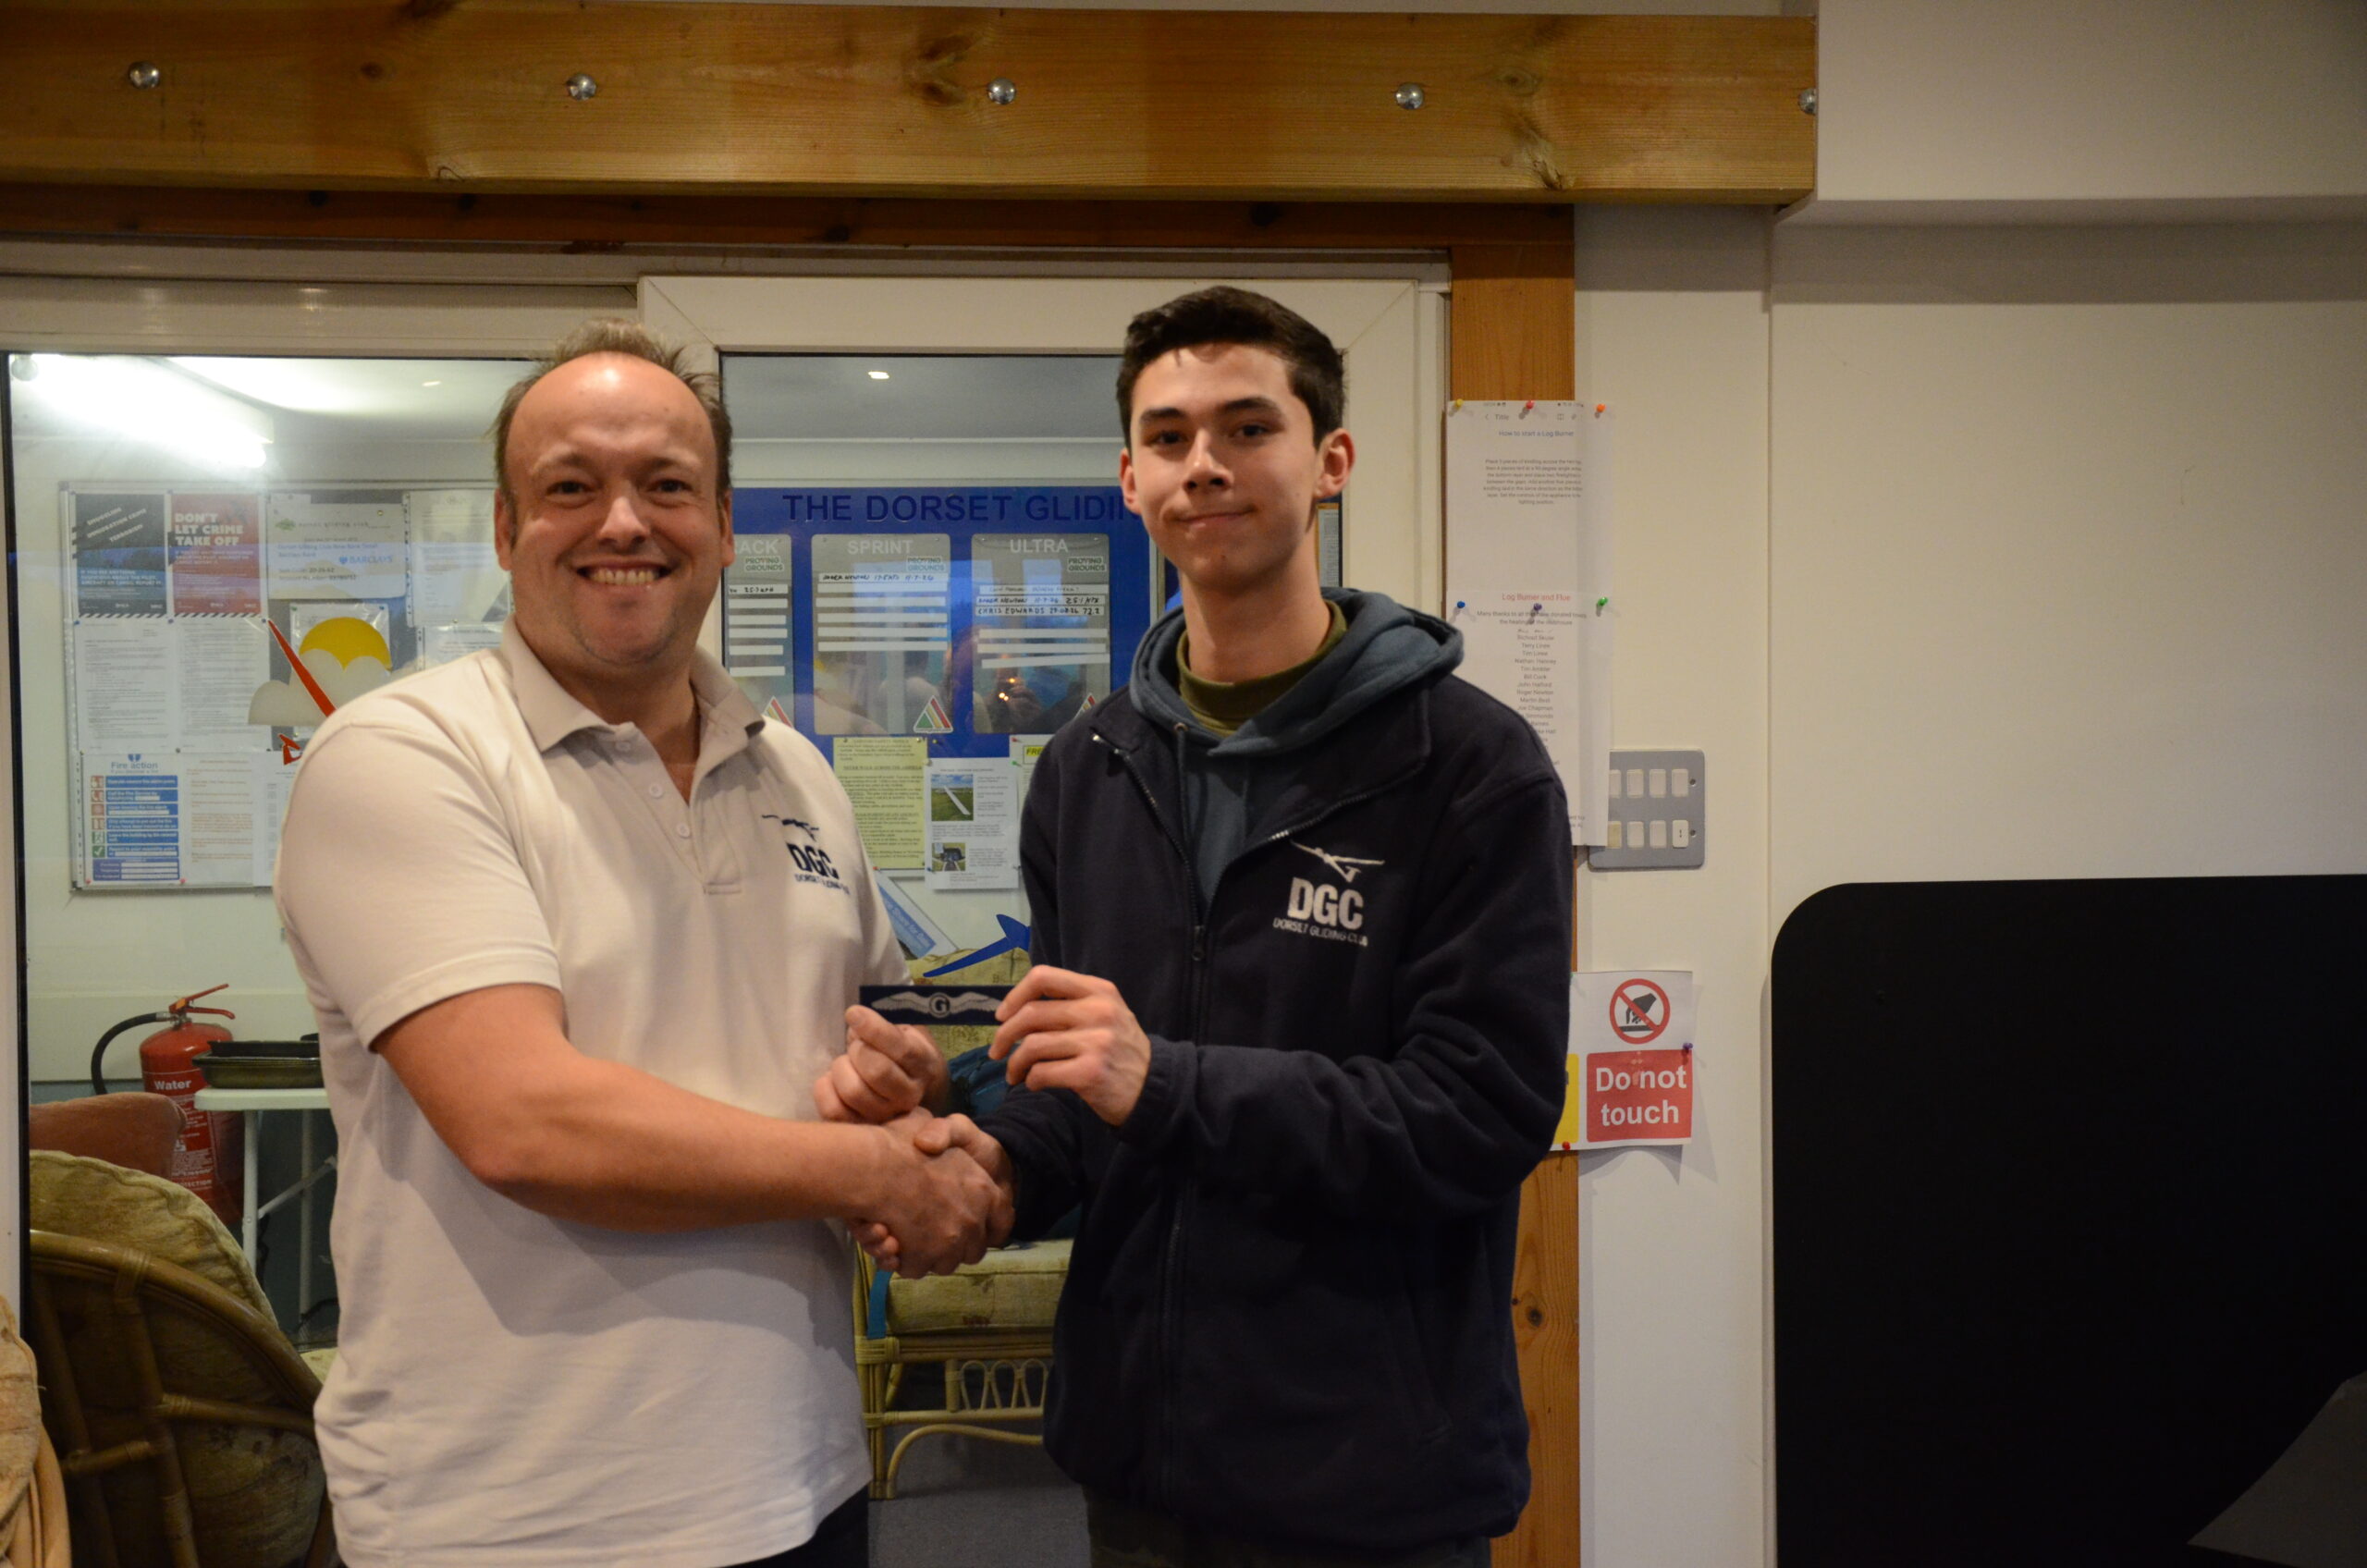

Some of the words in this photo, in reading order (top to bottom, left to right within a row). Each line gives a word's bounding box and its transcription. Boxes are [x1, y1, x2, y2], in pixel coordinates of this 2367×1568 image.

[782, 495, 852, 521] THE
[866, 495, 1012, 521] DORSET
[175, 513, 218, 523] DON'T
[175, 525, 199, 534] LET
[202, 525, 244, 534] CRIME
[175, 536, 211, 546] TAKE
[214, 536, 239, 546] OFF
[847, 540, 914, 555] SPRINT
[1010, 539, 1069, 553] ULTRA
[1502, 594, 1515, 602] Log
[1541, 594, 1554, 602] and
[1555, 594, 1571, 602] Flue
[786, 842, 840, 880] DGC
[1287, 877, 1364, 930] DGC
[1272, 918, 1308, 934] DORSET
[1309, 925, 1346, 941] GLIDING
[932, 998, 947, 1013] G
[153, 1080, 192, 1091] Water
[1596, 1067, 1632, 1092] Do
[1639, 1065, 1687, 1089] not
[1600, 1099, 1680, 1127] touch
